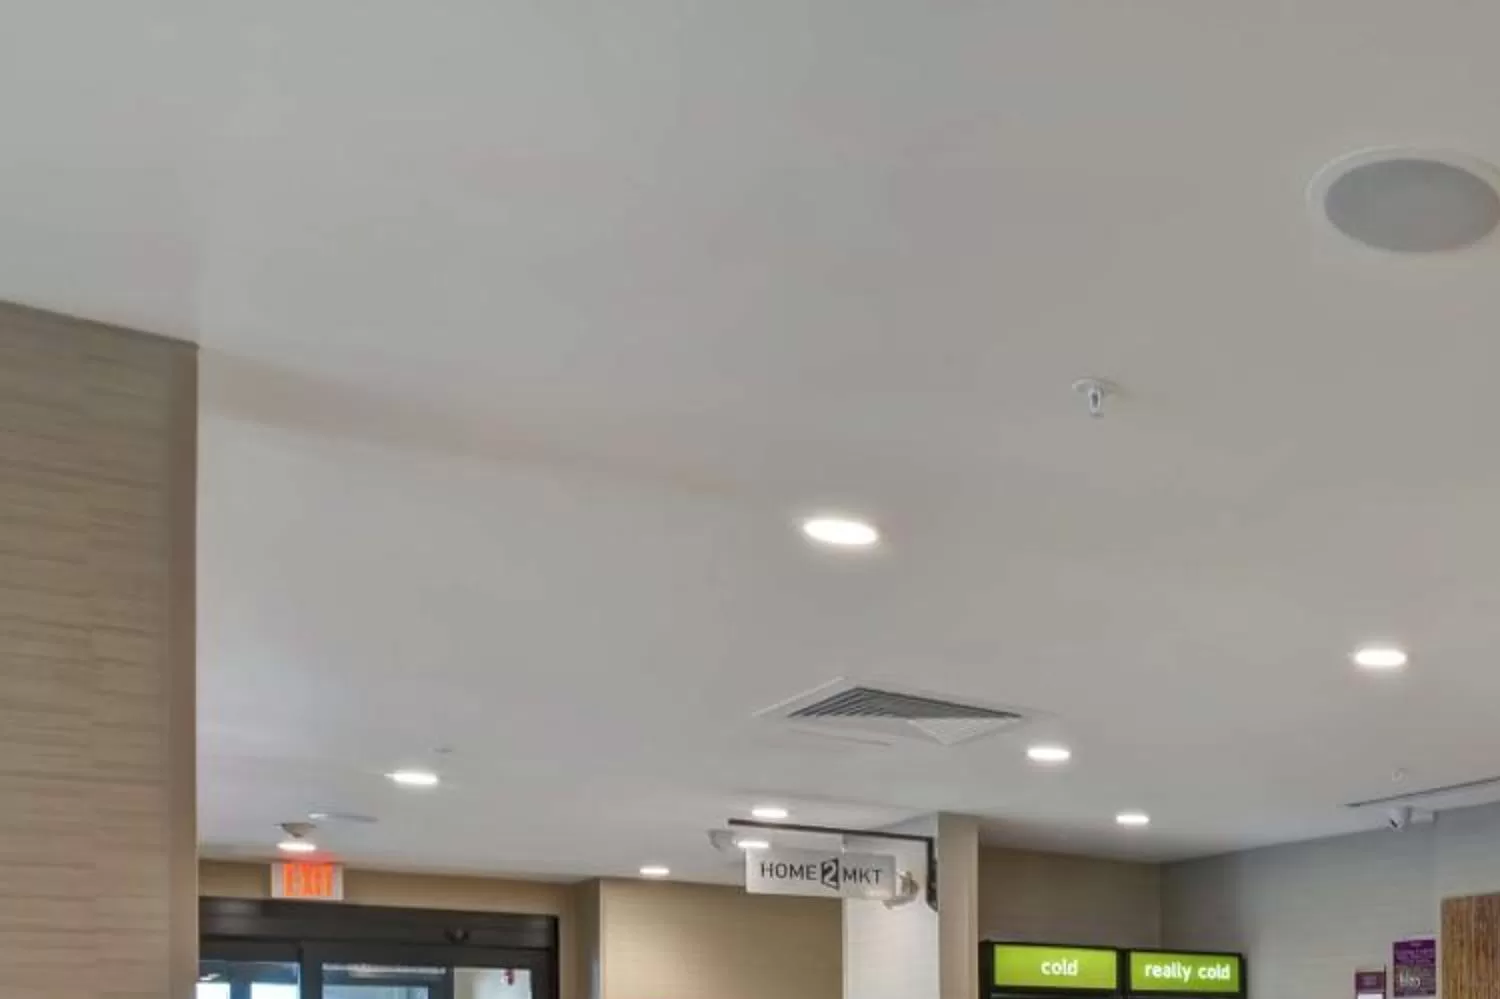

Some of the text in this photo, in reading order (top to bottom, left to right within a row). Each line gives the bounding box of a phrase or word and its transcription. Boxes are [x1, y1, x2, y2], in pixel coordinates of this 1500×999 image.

[283, 863, 335, 897] EXIT
[1040, 958, 1079, 977] cold
[1144, 961, 1231, 983] really cold
